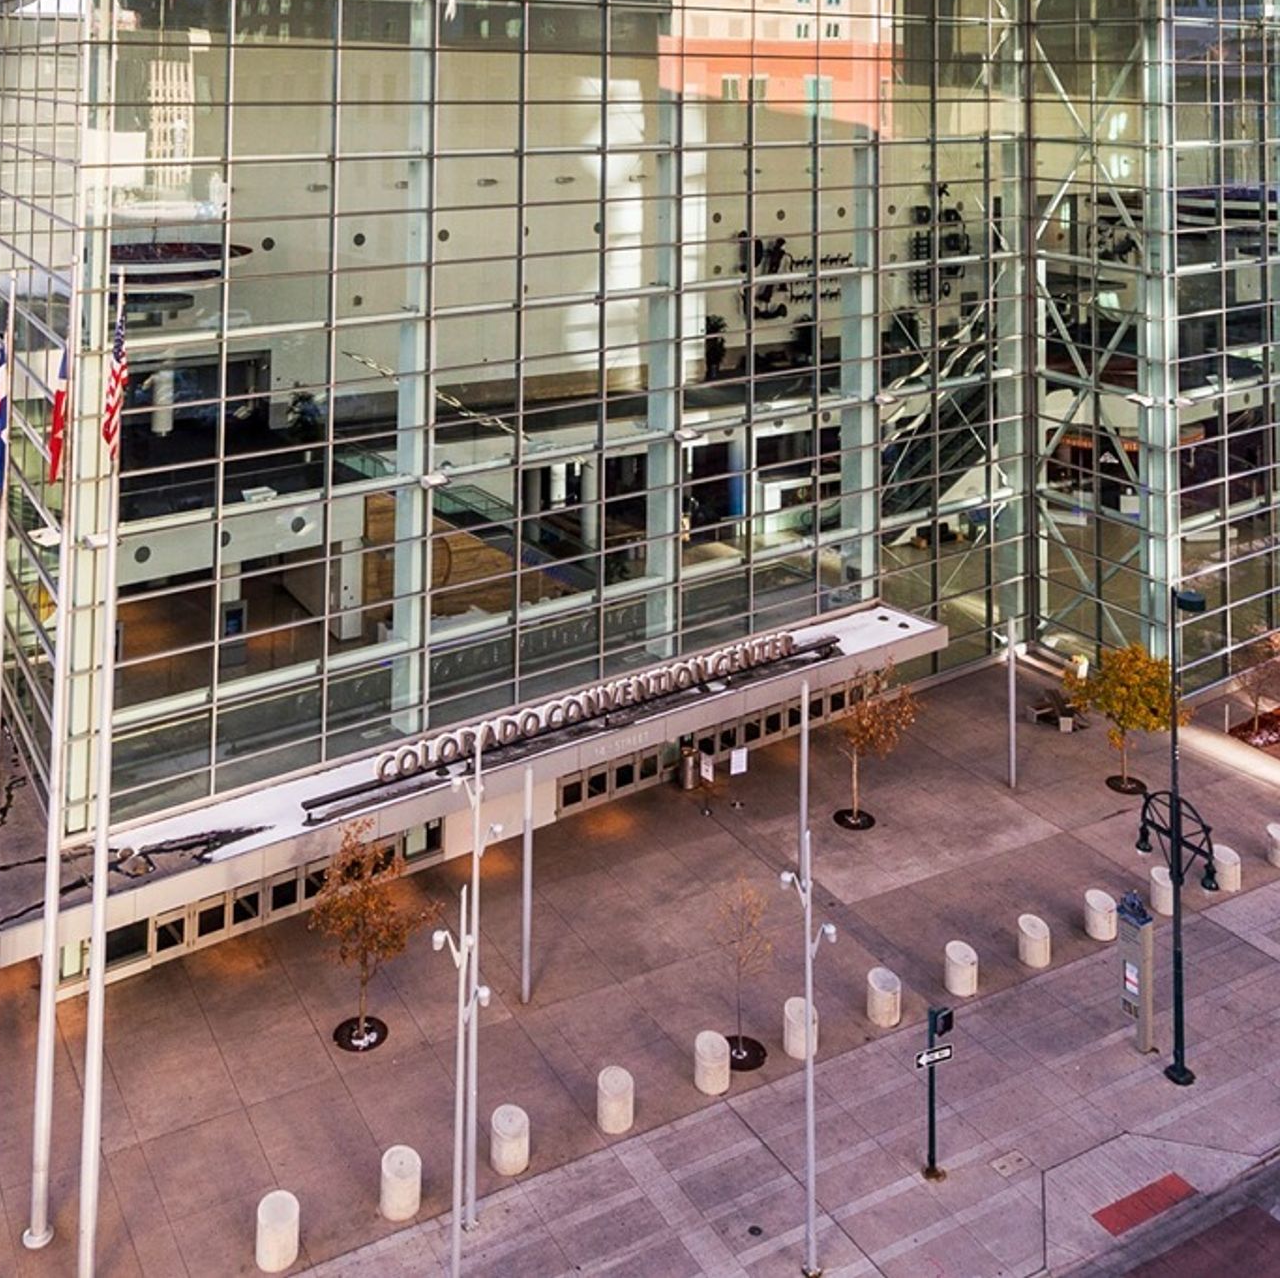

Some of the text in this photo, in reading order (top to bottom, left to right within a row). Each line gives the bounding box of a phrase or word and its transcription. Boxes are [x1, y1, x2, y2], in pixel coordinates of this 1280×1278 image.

[376, 631, 796, 782] COLORADO CONVENTION CENTER
